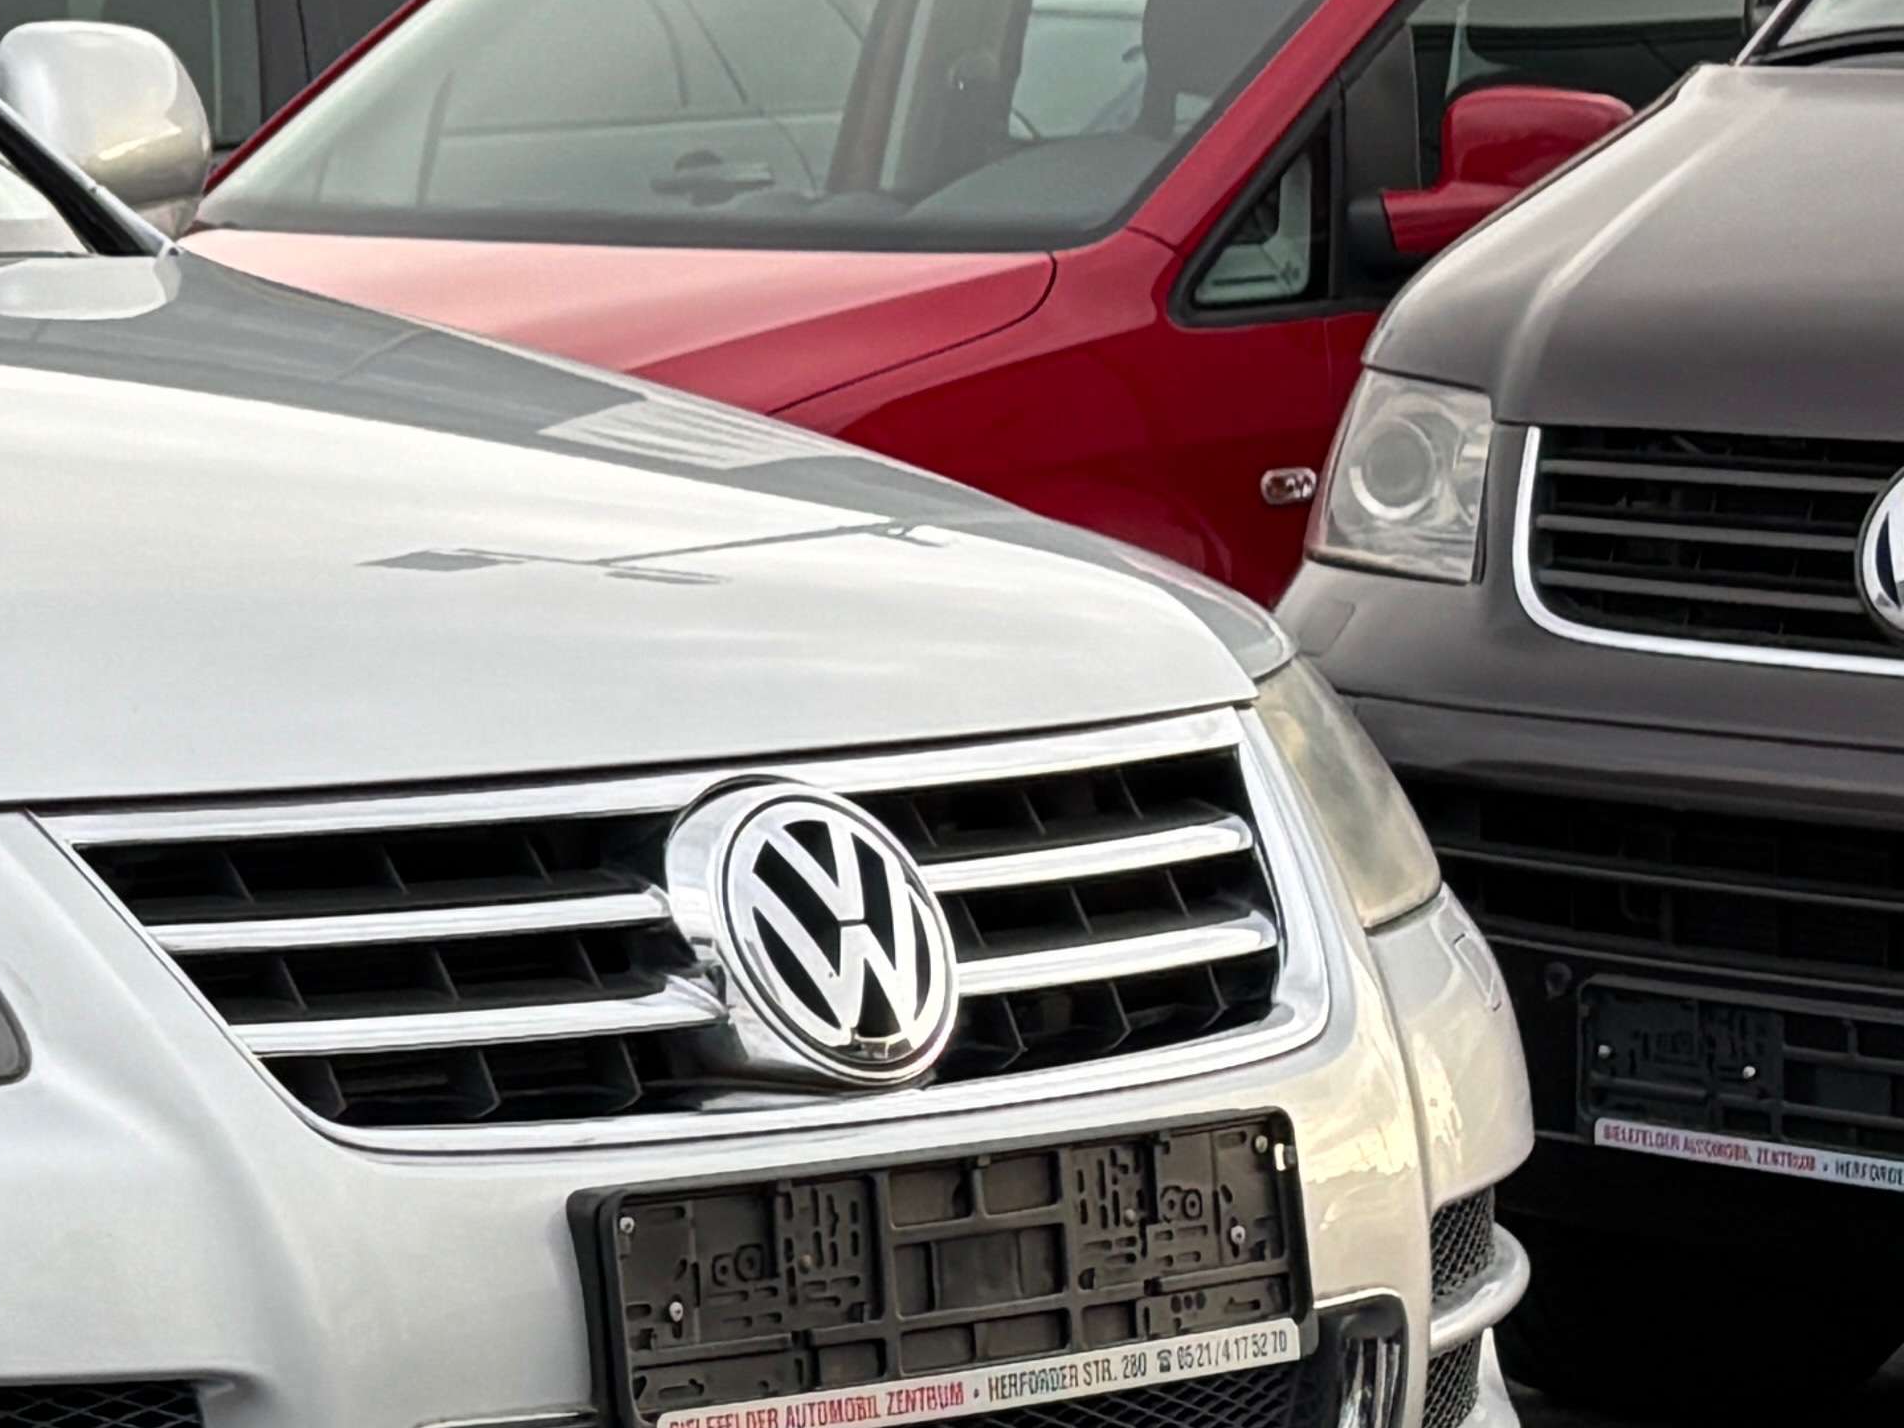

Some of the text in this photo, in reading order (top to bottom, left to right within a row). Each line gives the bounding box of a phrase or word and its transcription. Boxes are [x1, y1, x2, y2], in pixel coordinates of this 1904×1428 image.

[725, 796, 944, 1058] VW
[885, 1382, 964, 1416] ZENTRUM
[987, 1364, 1079, 1403] HERFORDER
[1083, 1357, 1117, 1387] STR.
[1121, 1351, 1147, 1379] 280
